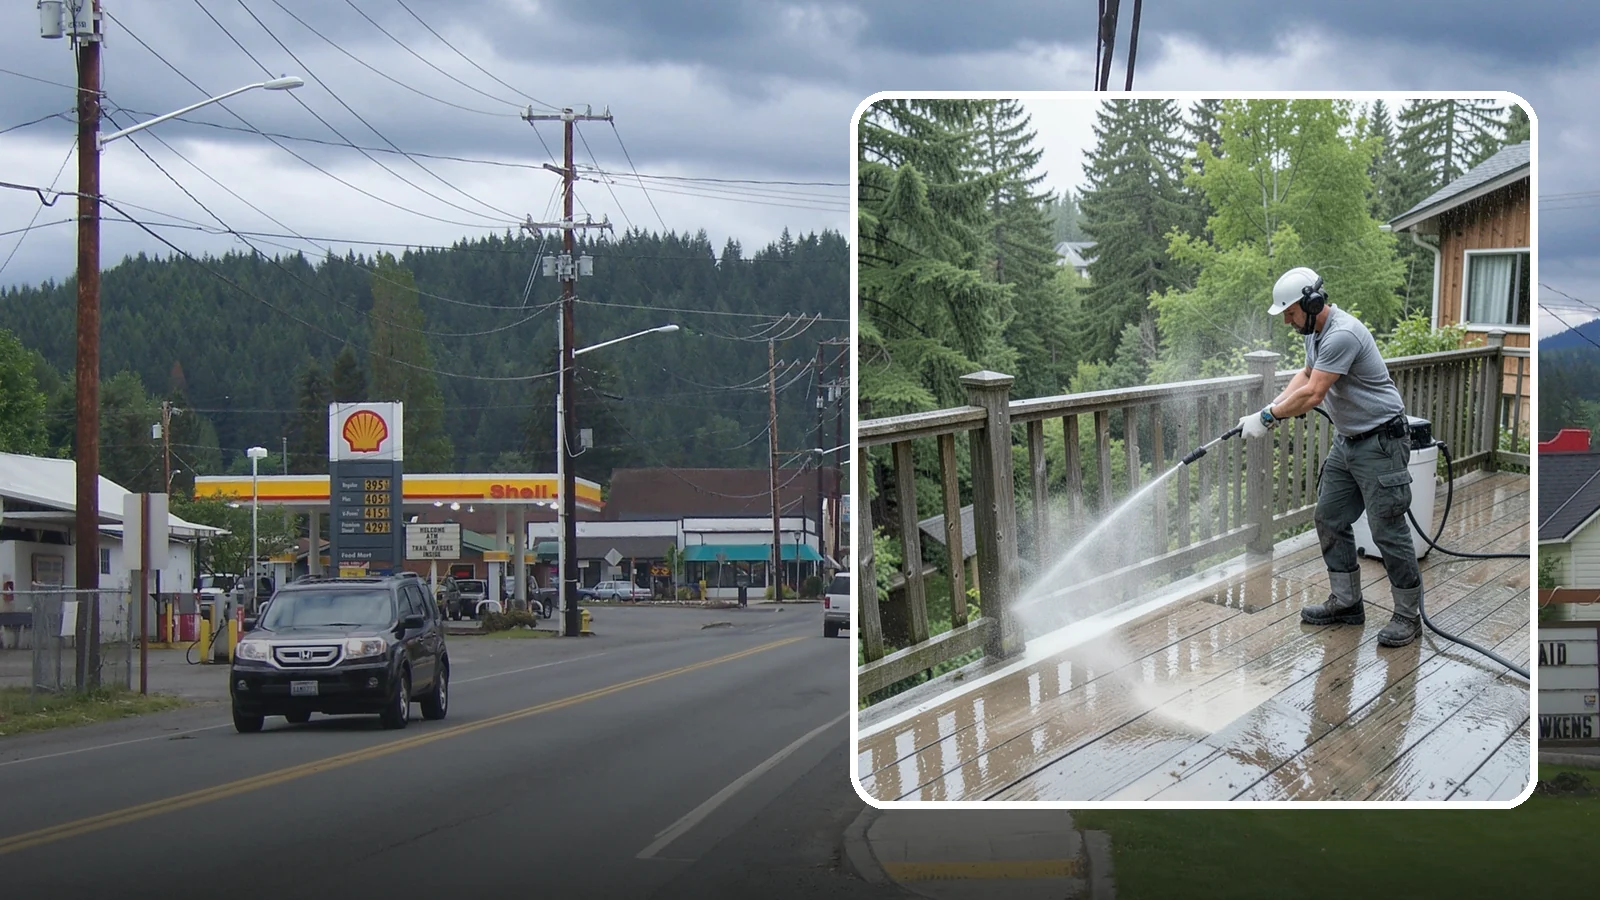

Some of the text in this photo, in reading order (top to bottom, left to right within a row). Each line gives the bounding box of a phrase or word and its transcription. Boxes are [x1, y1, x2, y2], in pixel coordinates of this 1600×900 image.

[366, 480, 383, 490] 395
[490, 484, 547, 499] Shell
[366, 494, 384, 504] 405
[366, 508, 384, 518] 415
[366, 522, 384, 532] 429
